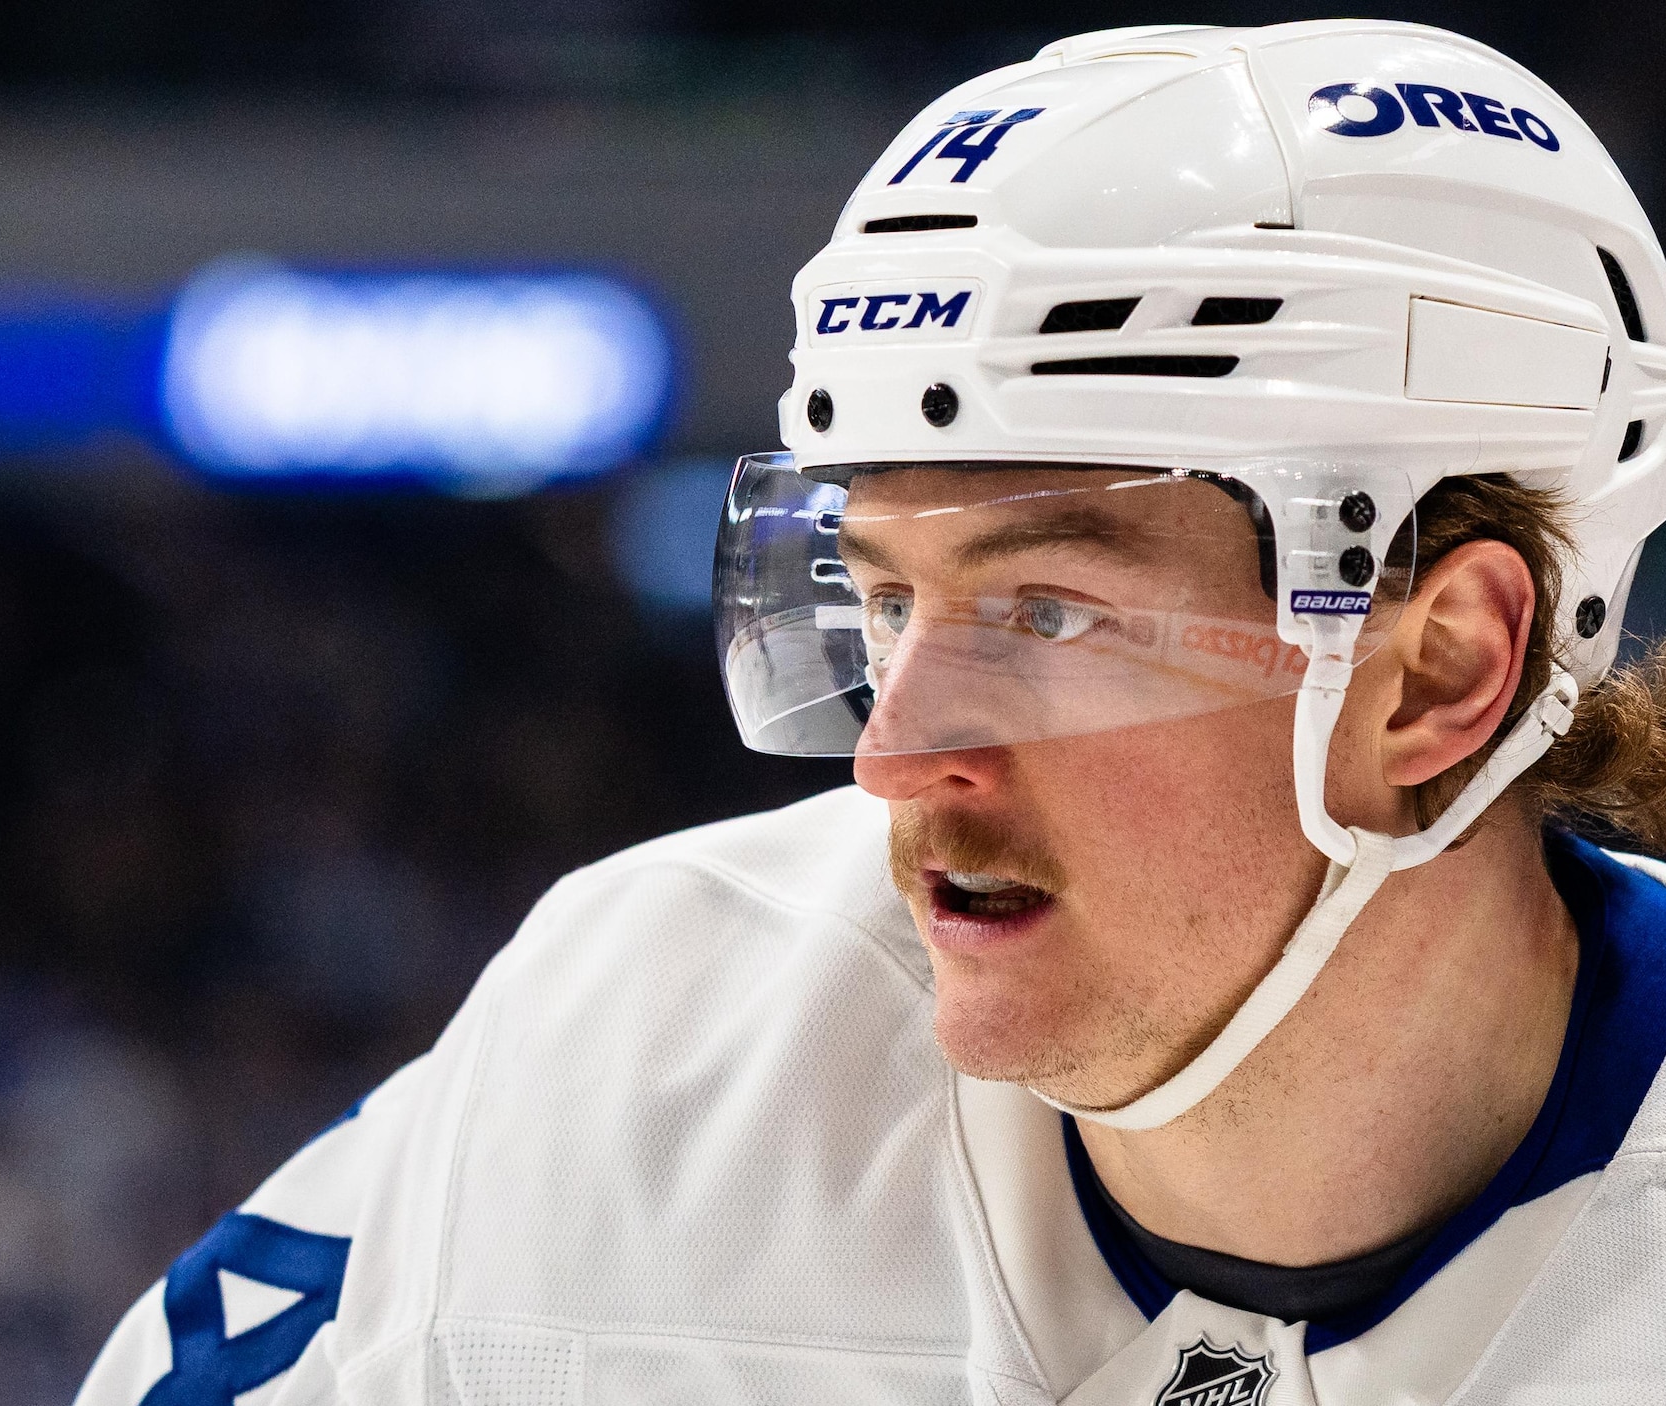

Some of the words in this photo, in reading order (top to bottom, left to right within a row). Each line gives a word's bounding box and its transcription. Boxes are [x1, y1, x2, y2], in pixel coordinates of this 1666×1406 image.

[887, 107, 1047, 186] 74
[1308, 82, 1561, 153] OREO
[816, 291, 973, 335] CCM
